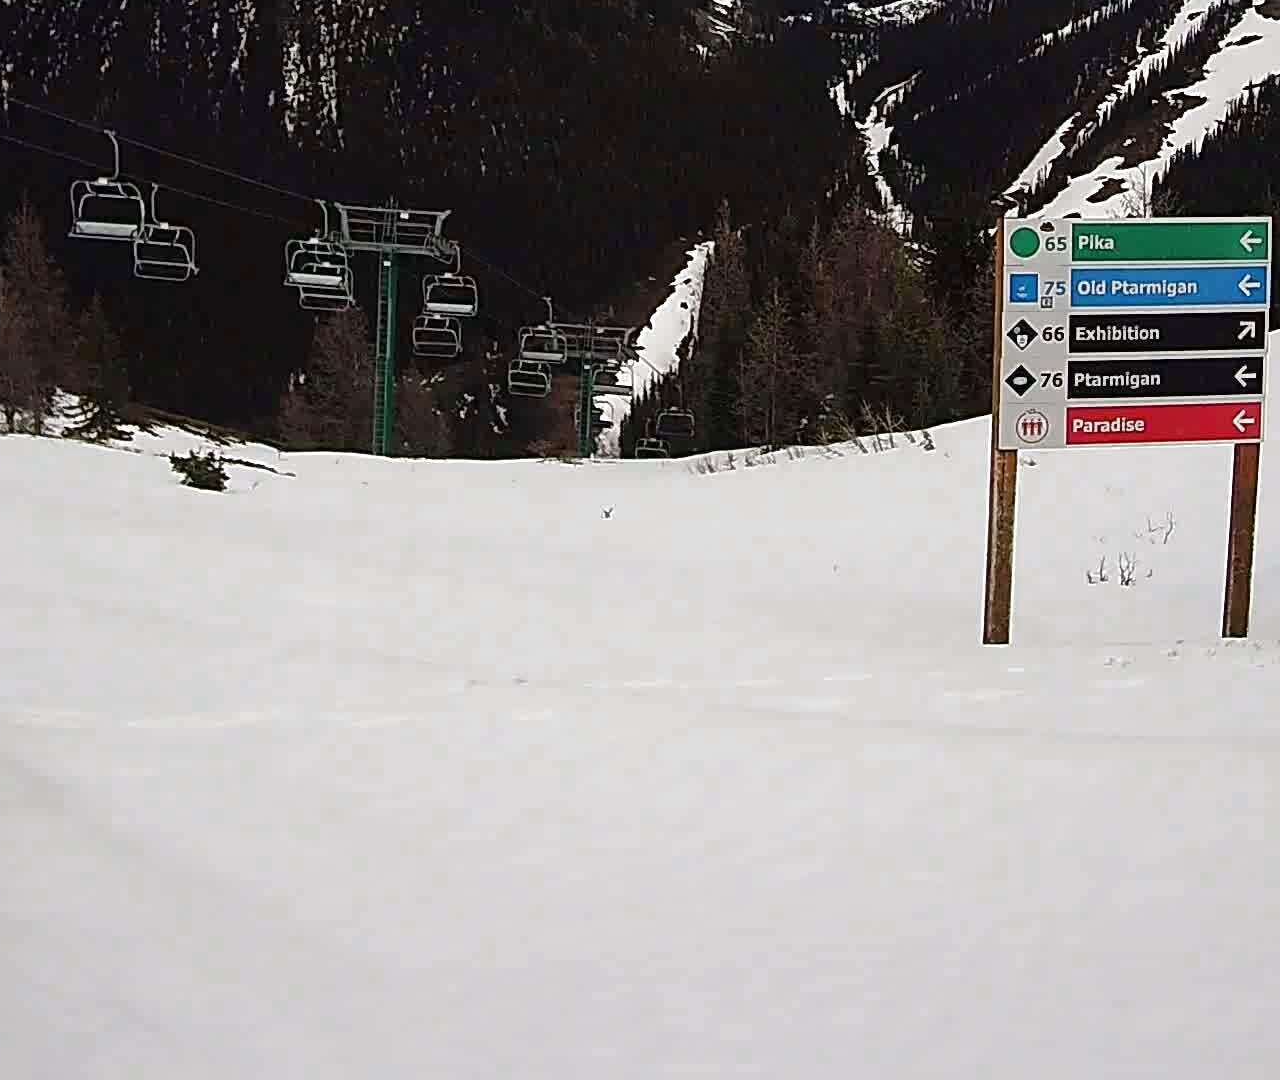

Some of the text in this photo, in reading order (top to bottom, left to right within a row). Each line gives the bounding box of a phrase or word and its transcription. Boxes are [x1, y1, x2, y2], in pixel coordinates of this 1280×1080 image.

[1045, 234, 1114, 251] 65 Pika
[1043, 280, 1198, 297] 75 Old Ptarmigan
[1042, 325, 1160, 342] 66 Exhibition
[1040, 372, 1161, 389] 76 Ptarmigan
[1072, 417, 1145, 433] Paradise
